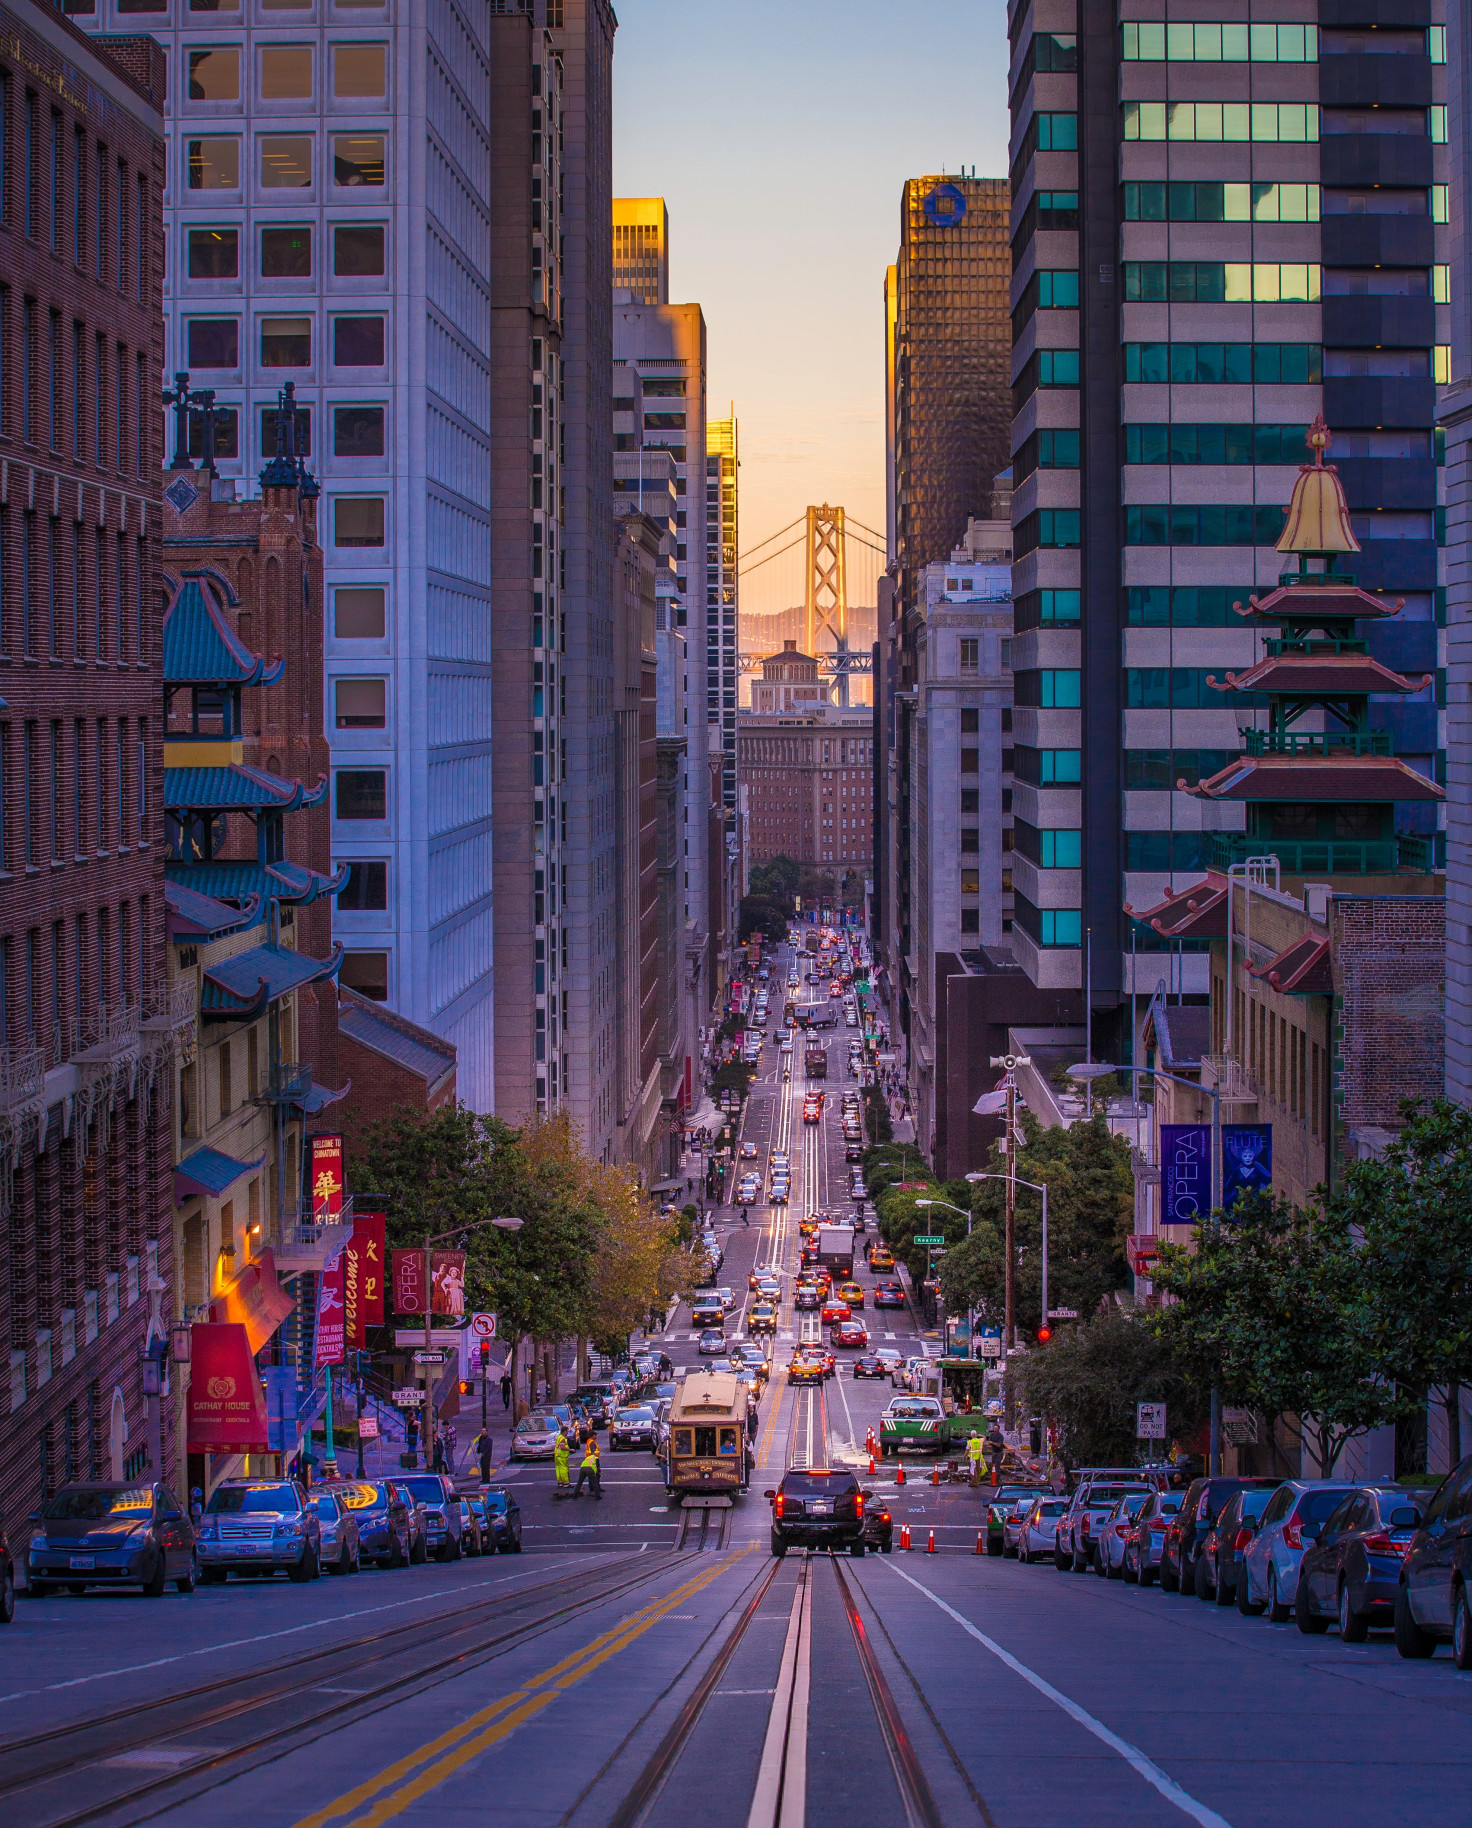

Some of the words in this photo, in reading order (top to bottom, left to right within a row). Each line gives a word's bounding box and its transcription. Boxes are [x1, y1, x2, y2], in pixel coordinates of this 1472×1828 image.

[312, 1139, 334, 1149] WELCOME
[335, 1138, 342, 1148] TO
[1225, 1135, 1268, 1148] FLUTE
[314, 1148, 340, 1158] CHINATOWN
[1175, 1130, 1199, 1220] OPERA
[401, 1253, 418, 1311] OPERA
[193, 1402, 222, 1410] CATHAY
[225, 1402, 251, 1410] HOUSE
